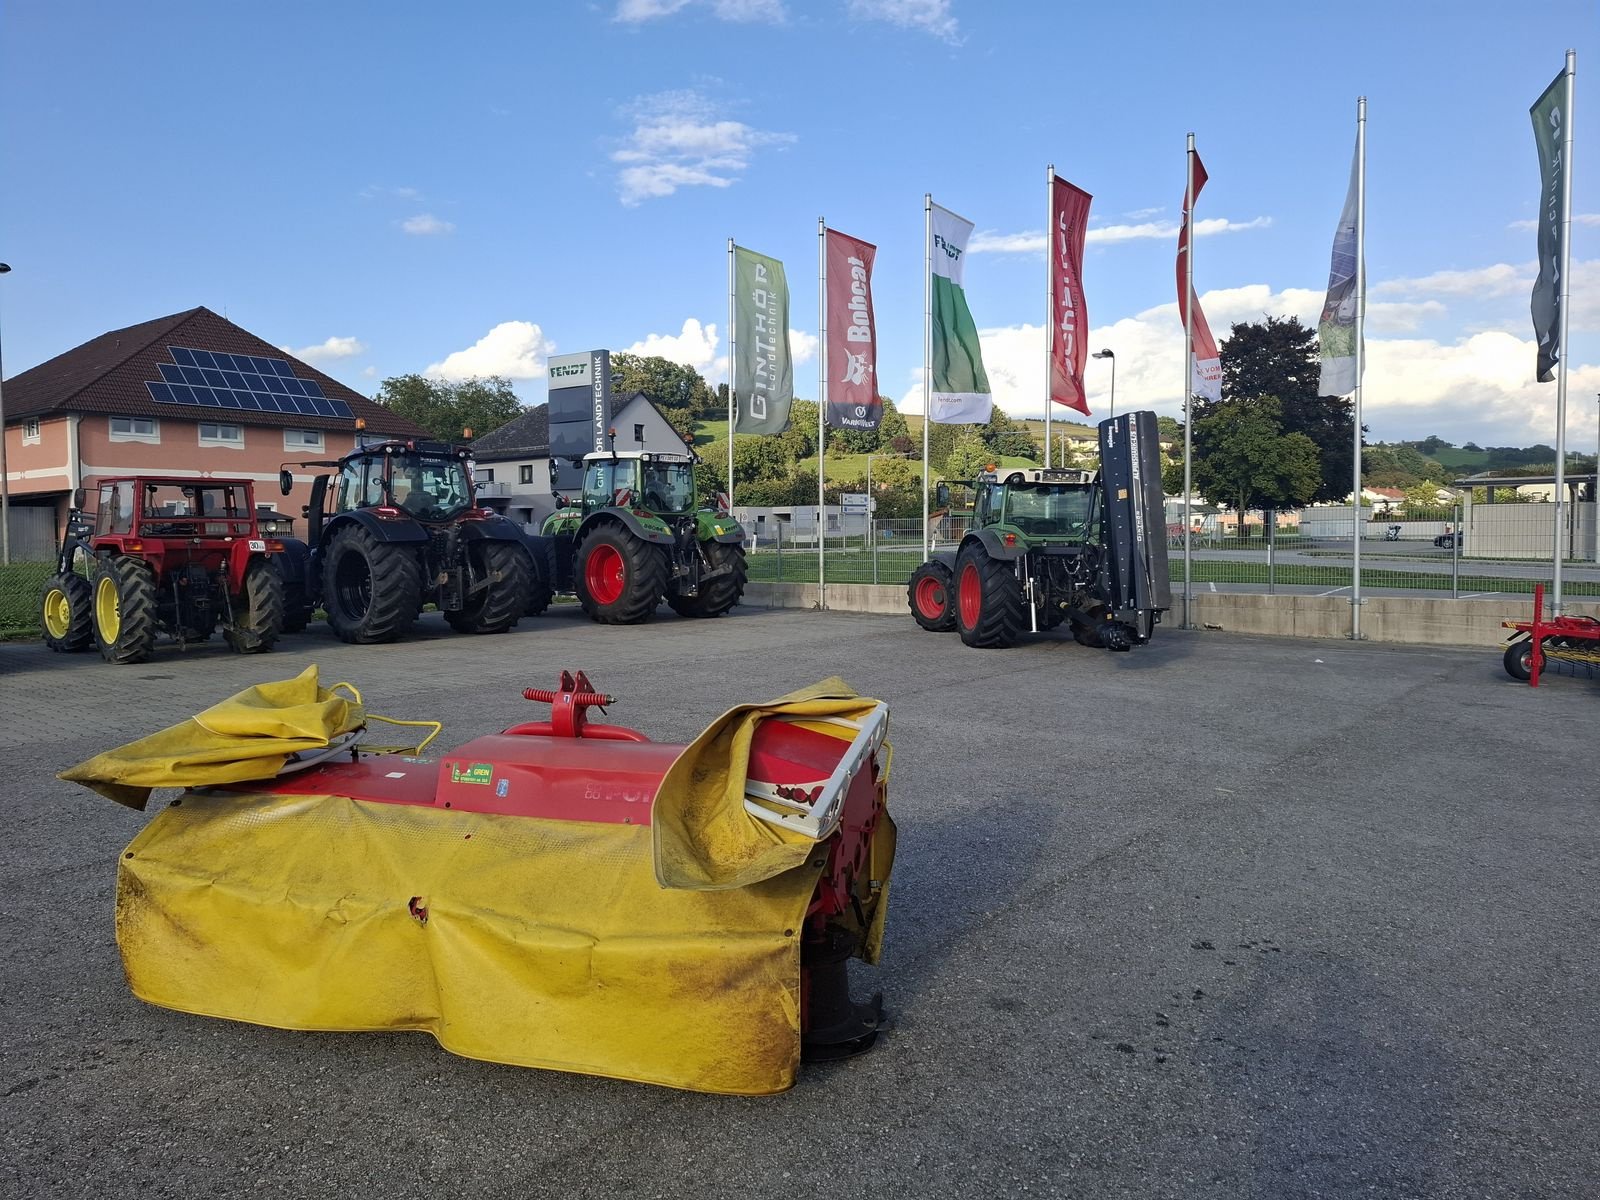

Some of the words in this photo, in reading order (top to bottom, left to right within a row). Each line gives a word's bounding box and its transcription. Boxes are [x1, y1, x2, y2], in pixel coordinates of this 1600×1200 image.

[847, 256, 871, 342] Bobcat
[550, 363, 588, 377] FENDT
[750, 263, 768, 420] GINTHÖR
[594, 356, 603, 435] LANDTECHNIK
[250, 541, 258, 549] 30
